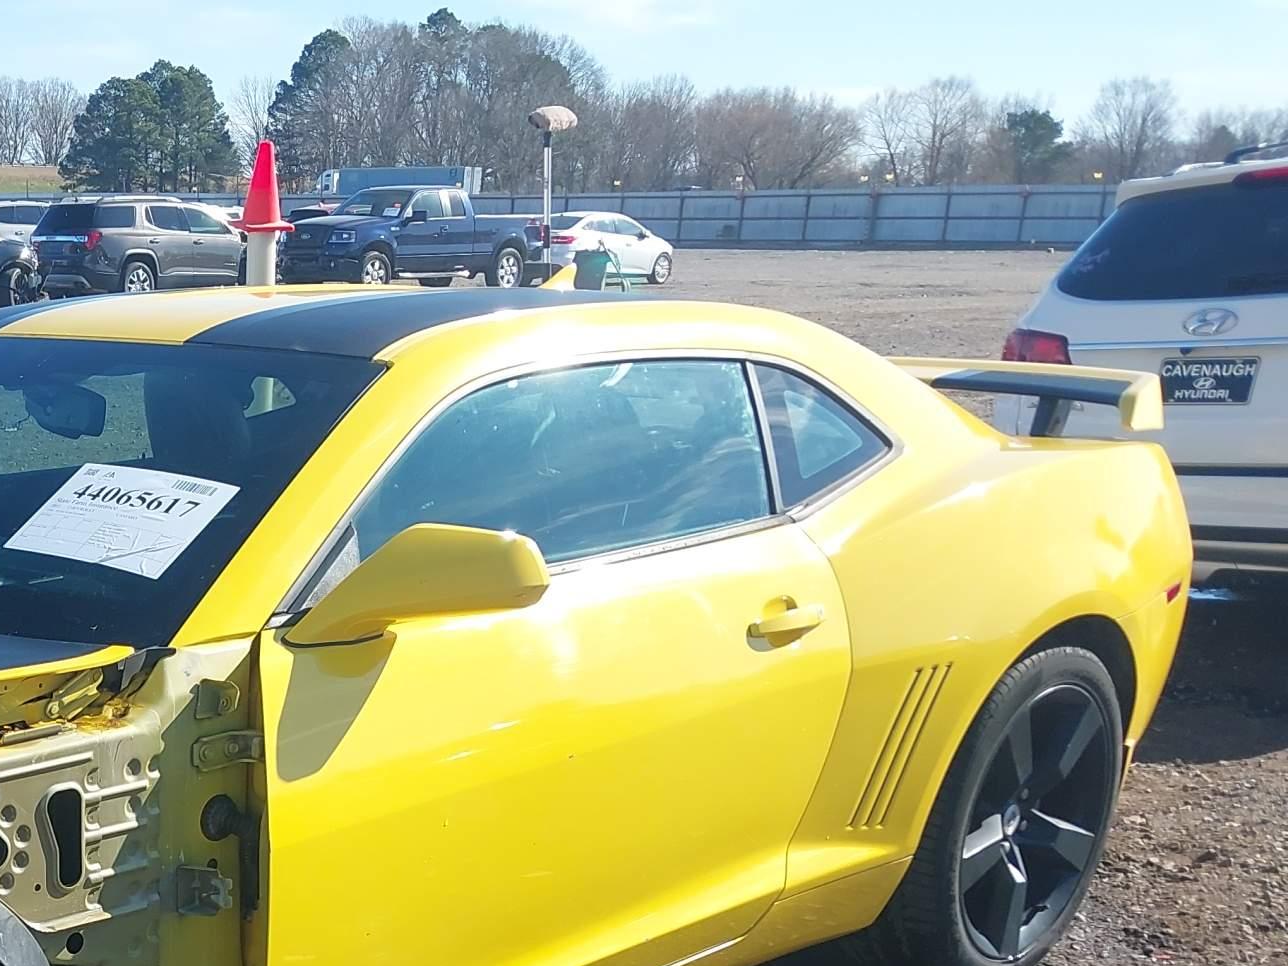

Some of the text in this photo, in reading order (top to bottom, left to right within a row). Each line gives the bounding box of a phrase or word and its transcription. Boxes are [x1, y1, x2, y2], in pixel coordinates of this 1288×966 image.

[1162, 363, 1257, 377] CAVENAUGH
[1174, 389, 1230, 400] HYUNDAI
[73, 483, 201, 518] 44065617
